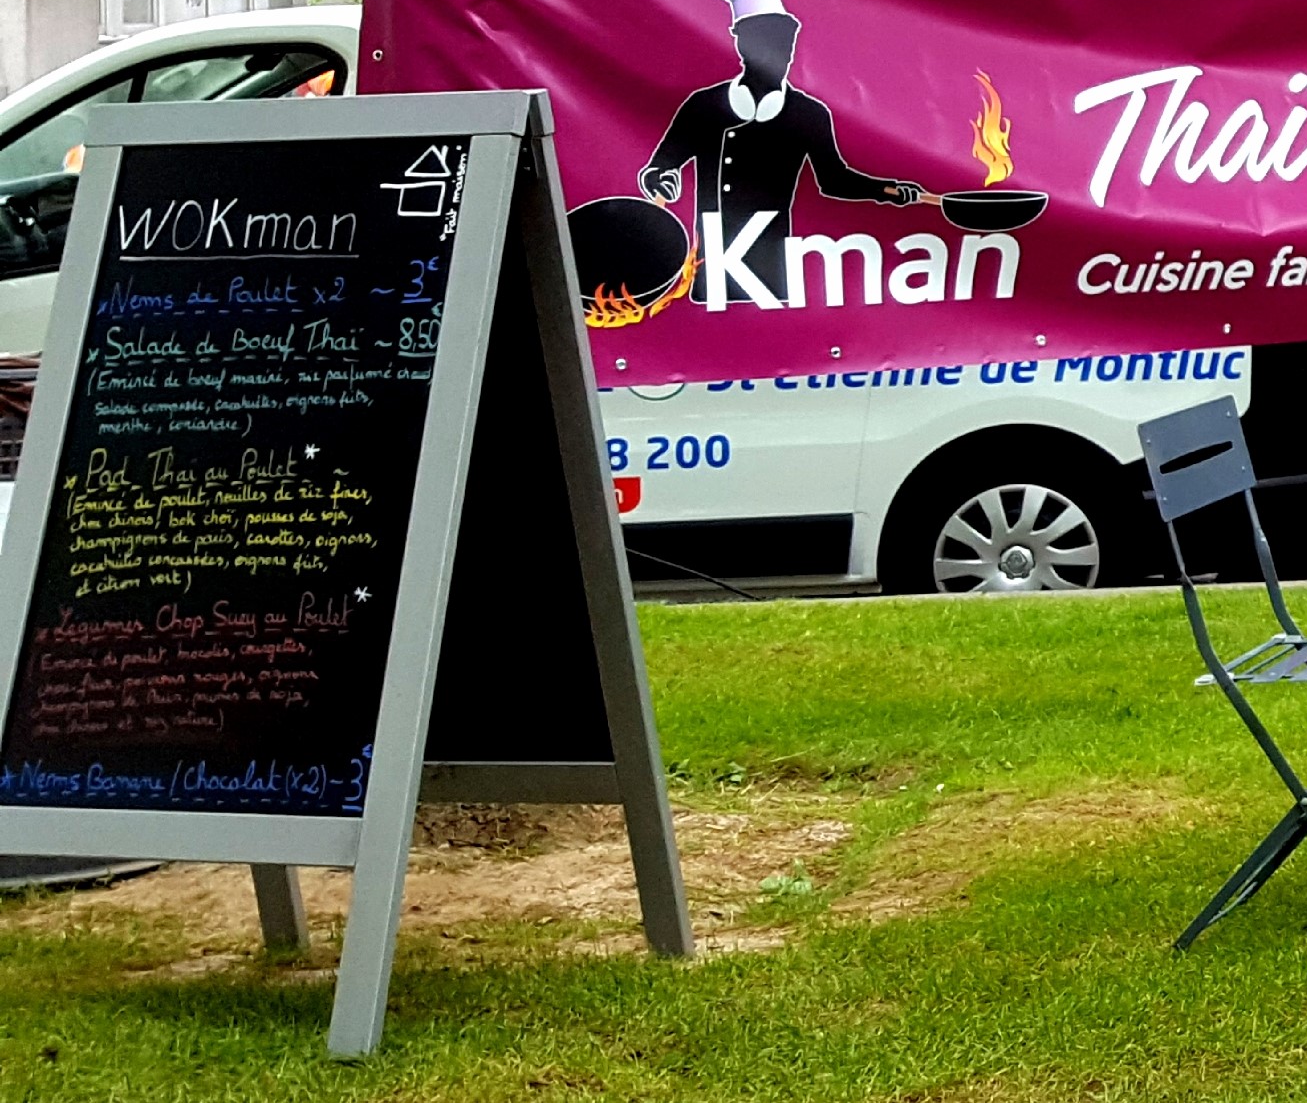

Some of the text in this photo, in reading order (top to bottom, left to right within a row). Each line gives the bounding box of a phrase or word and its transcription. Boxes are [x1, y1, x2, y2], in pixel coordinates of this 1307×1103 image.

[119, 197, 356, 252] WOKman
[1077, 249, 1254, 295] Cuisine
[110, 275, 174, 313] Nems
[186, 282, 219, 304] de
[228, 274, 299, 304] Poulet
[105, 325, 188, 359] Salade
[196, 331, 221, 355] de
[232, 323, 296, 362] Boeuf
[163, 370, 182, 388] de
[86, 447, 132, 488] Pad
[205, 468, 230, 481] au
[238, 446, 299, 480] Poulet
[647, 435, 730, 469] 200
[133, 491, 156, 510] de
[274, 483, 295, 502] de
[299, 508, 318, 523] de
[172, 530, 192, 545] de
[156, 603, 205, 639] Chop
[211, 599, 259, 639] Suey
[264, 610, 289, 625] au
[298, 590, 354, 628] Poulet
[20, 758, 81, 792] Nems
[86, 762, 166, 793] Banane
